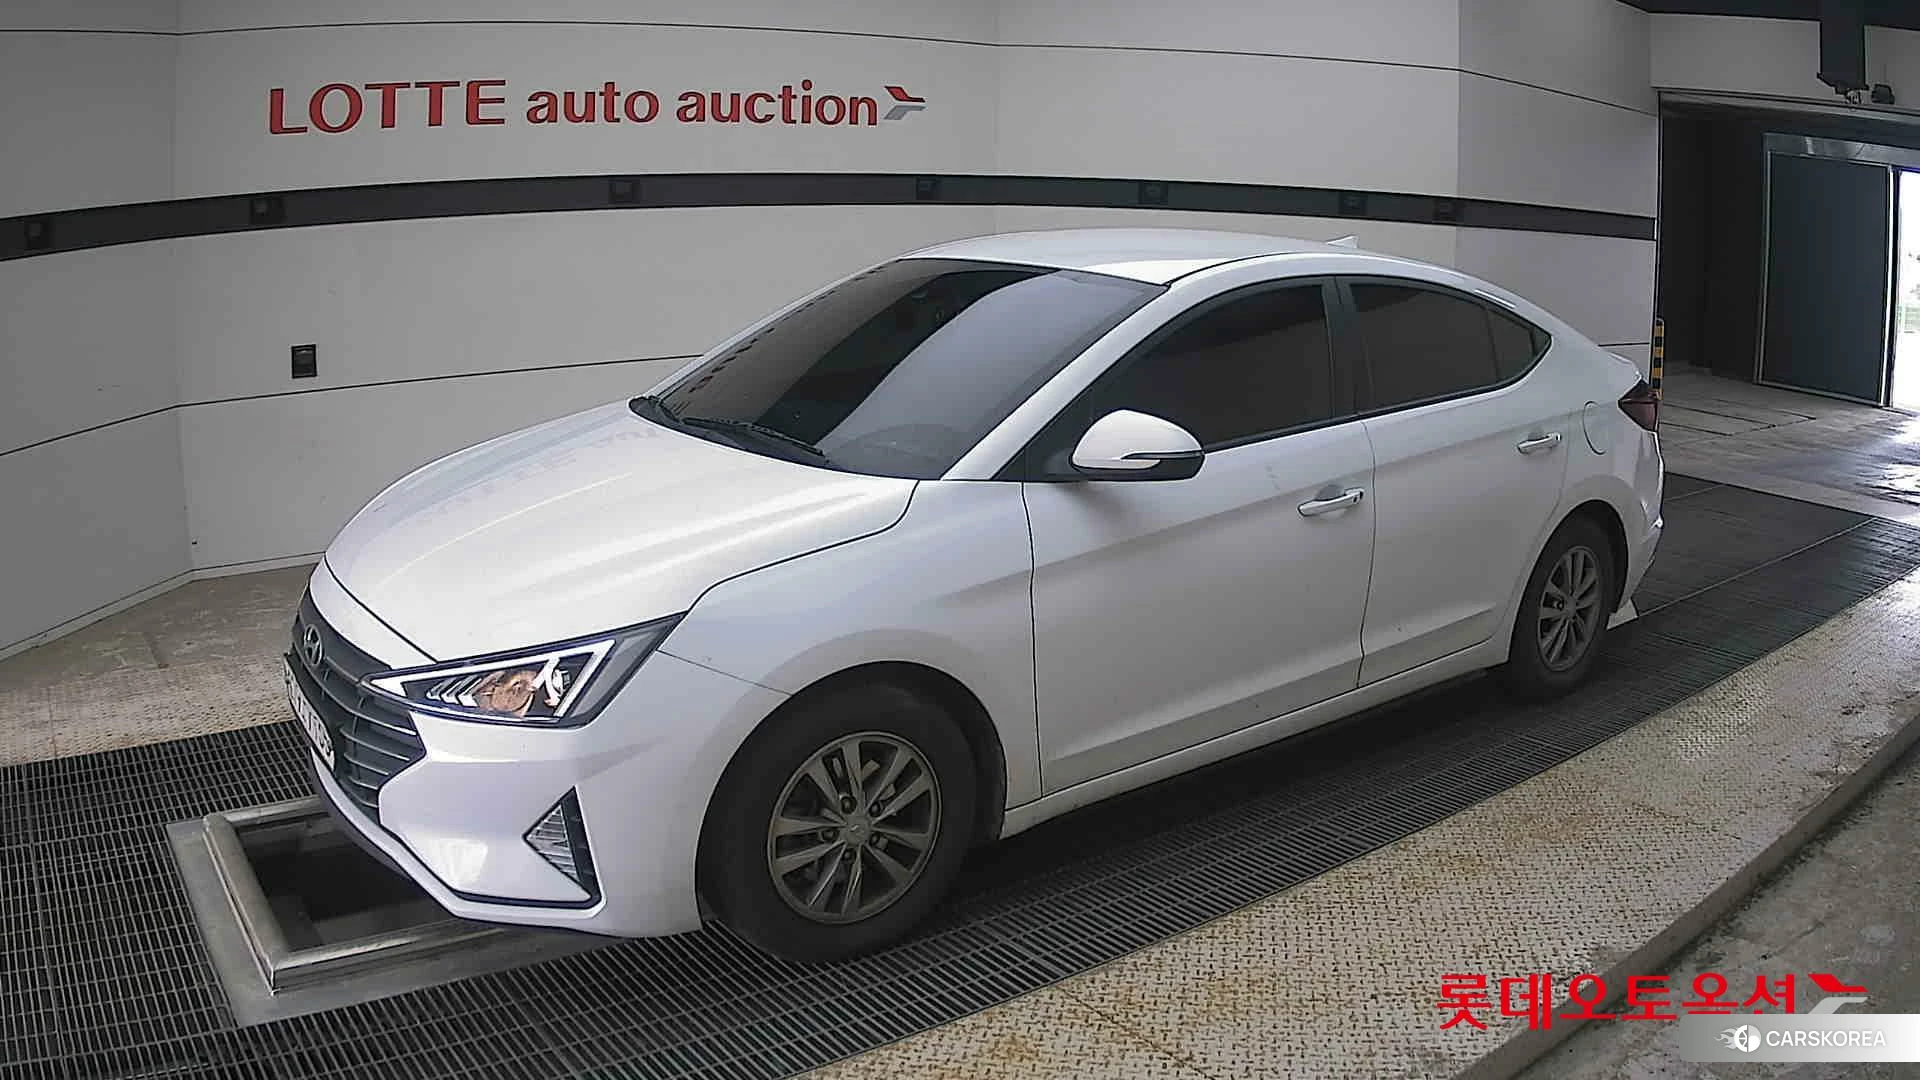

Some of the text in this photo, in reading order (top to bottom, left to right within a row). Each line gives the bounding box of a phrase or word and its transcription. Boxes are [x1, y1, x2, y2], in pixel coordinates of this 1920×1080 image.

[270, 79, 878, 135] LOTTE auto auction
